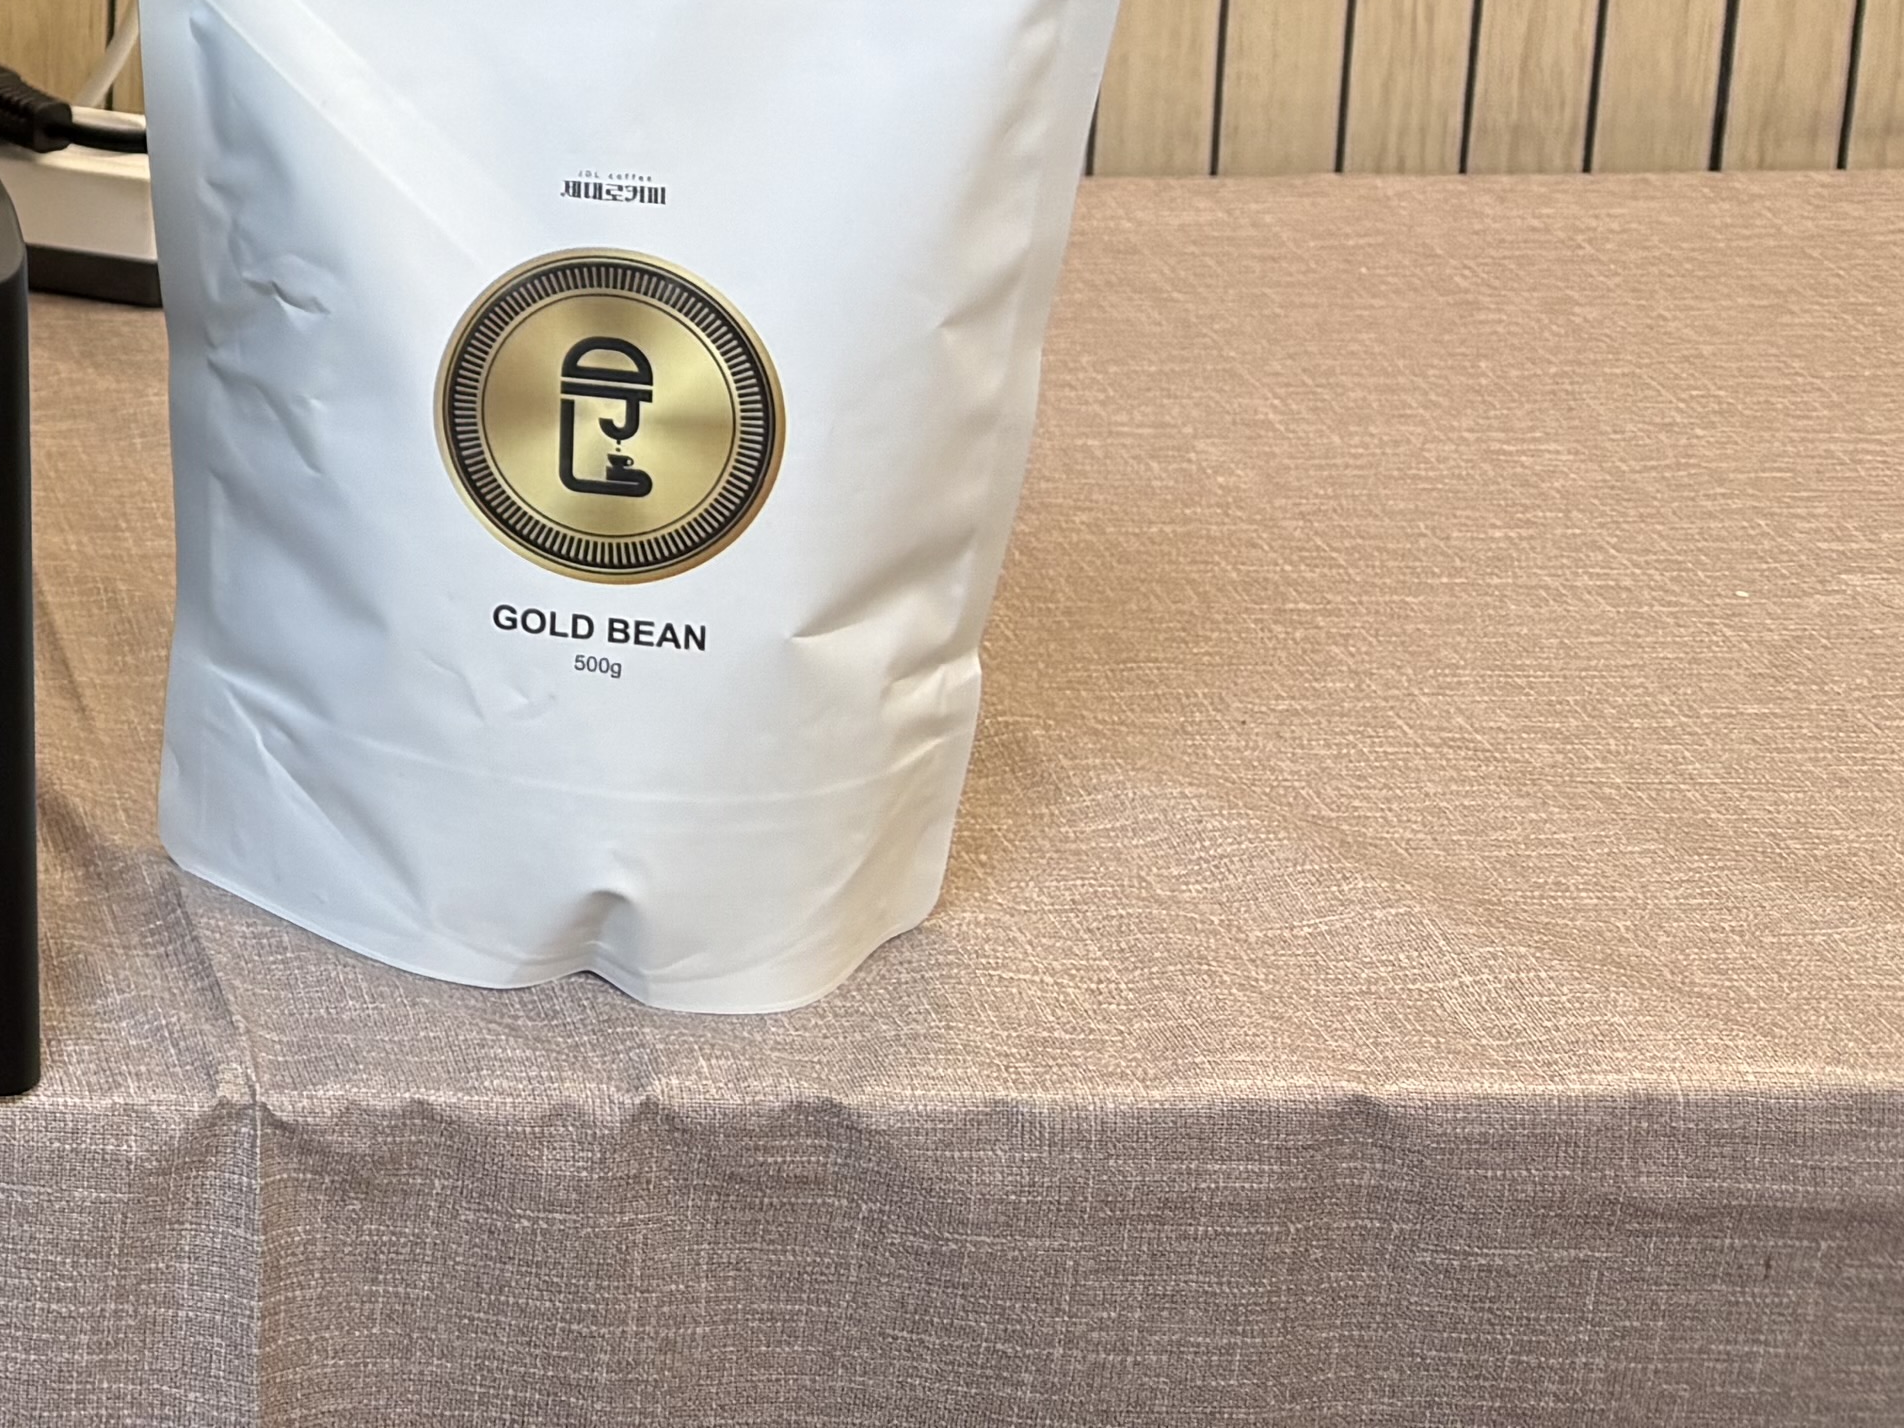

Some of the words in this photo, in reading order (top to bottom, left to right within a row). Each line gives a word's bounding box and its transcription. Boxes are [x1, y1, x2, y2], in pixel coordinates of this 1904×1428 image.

[493, 604, 594, 640] GOLD
[607, 617, 706, 651] BEAN
[574, 654, 622, 679] 500g
